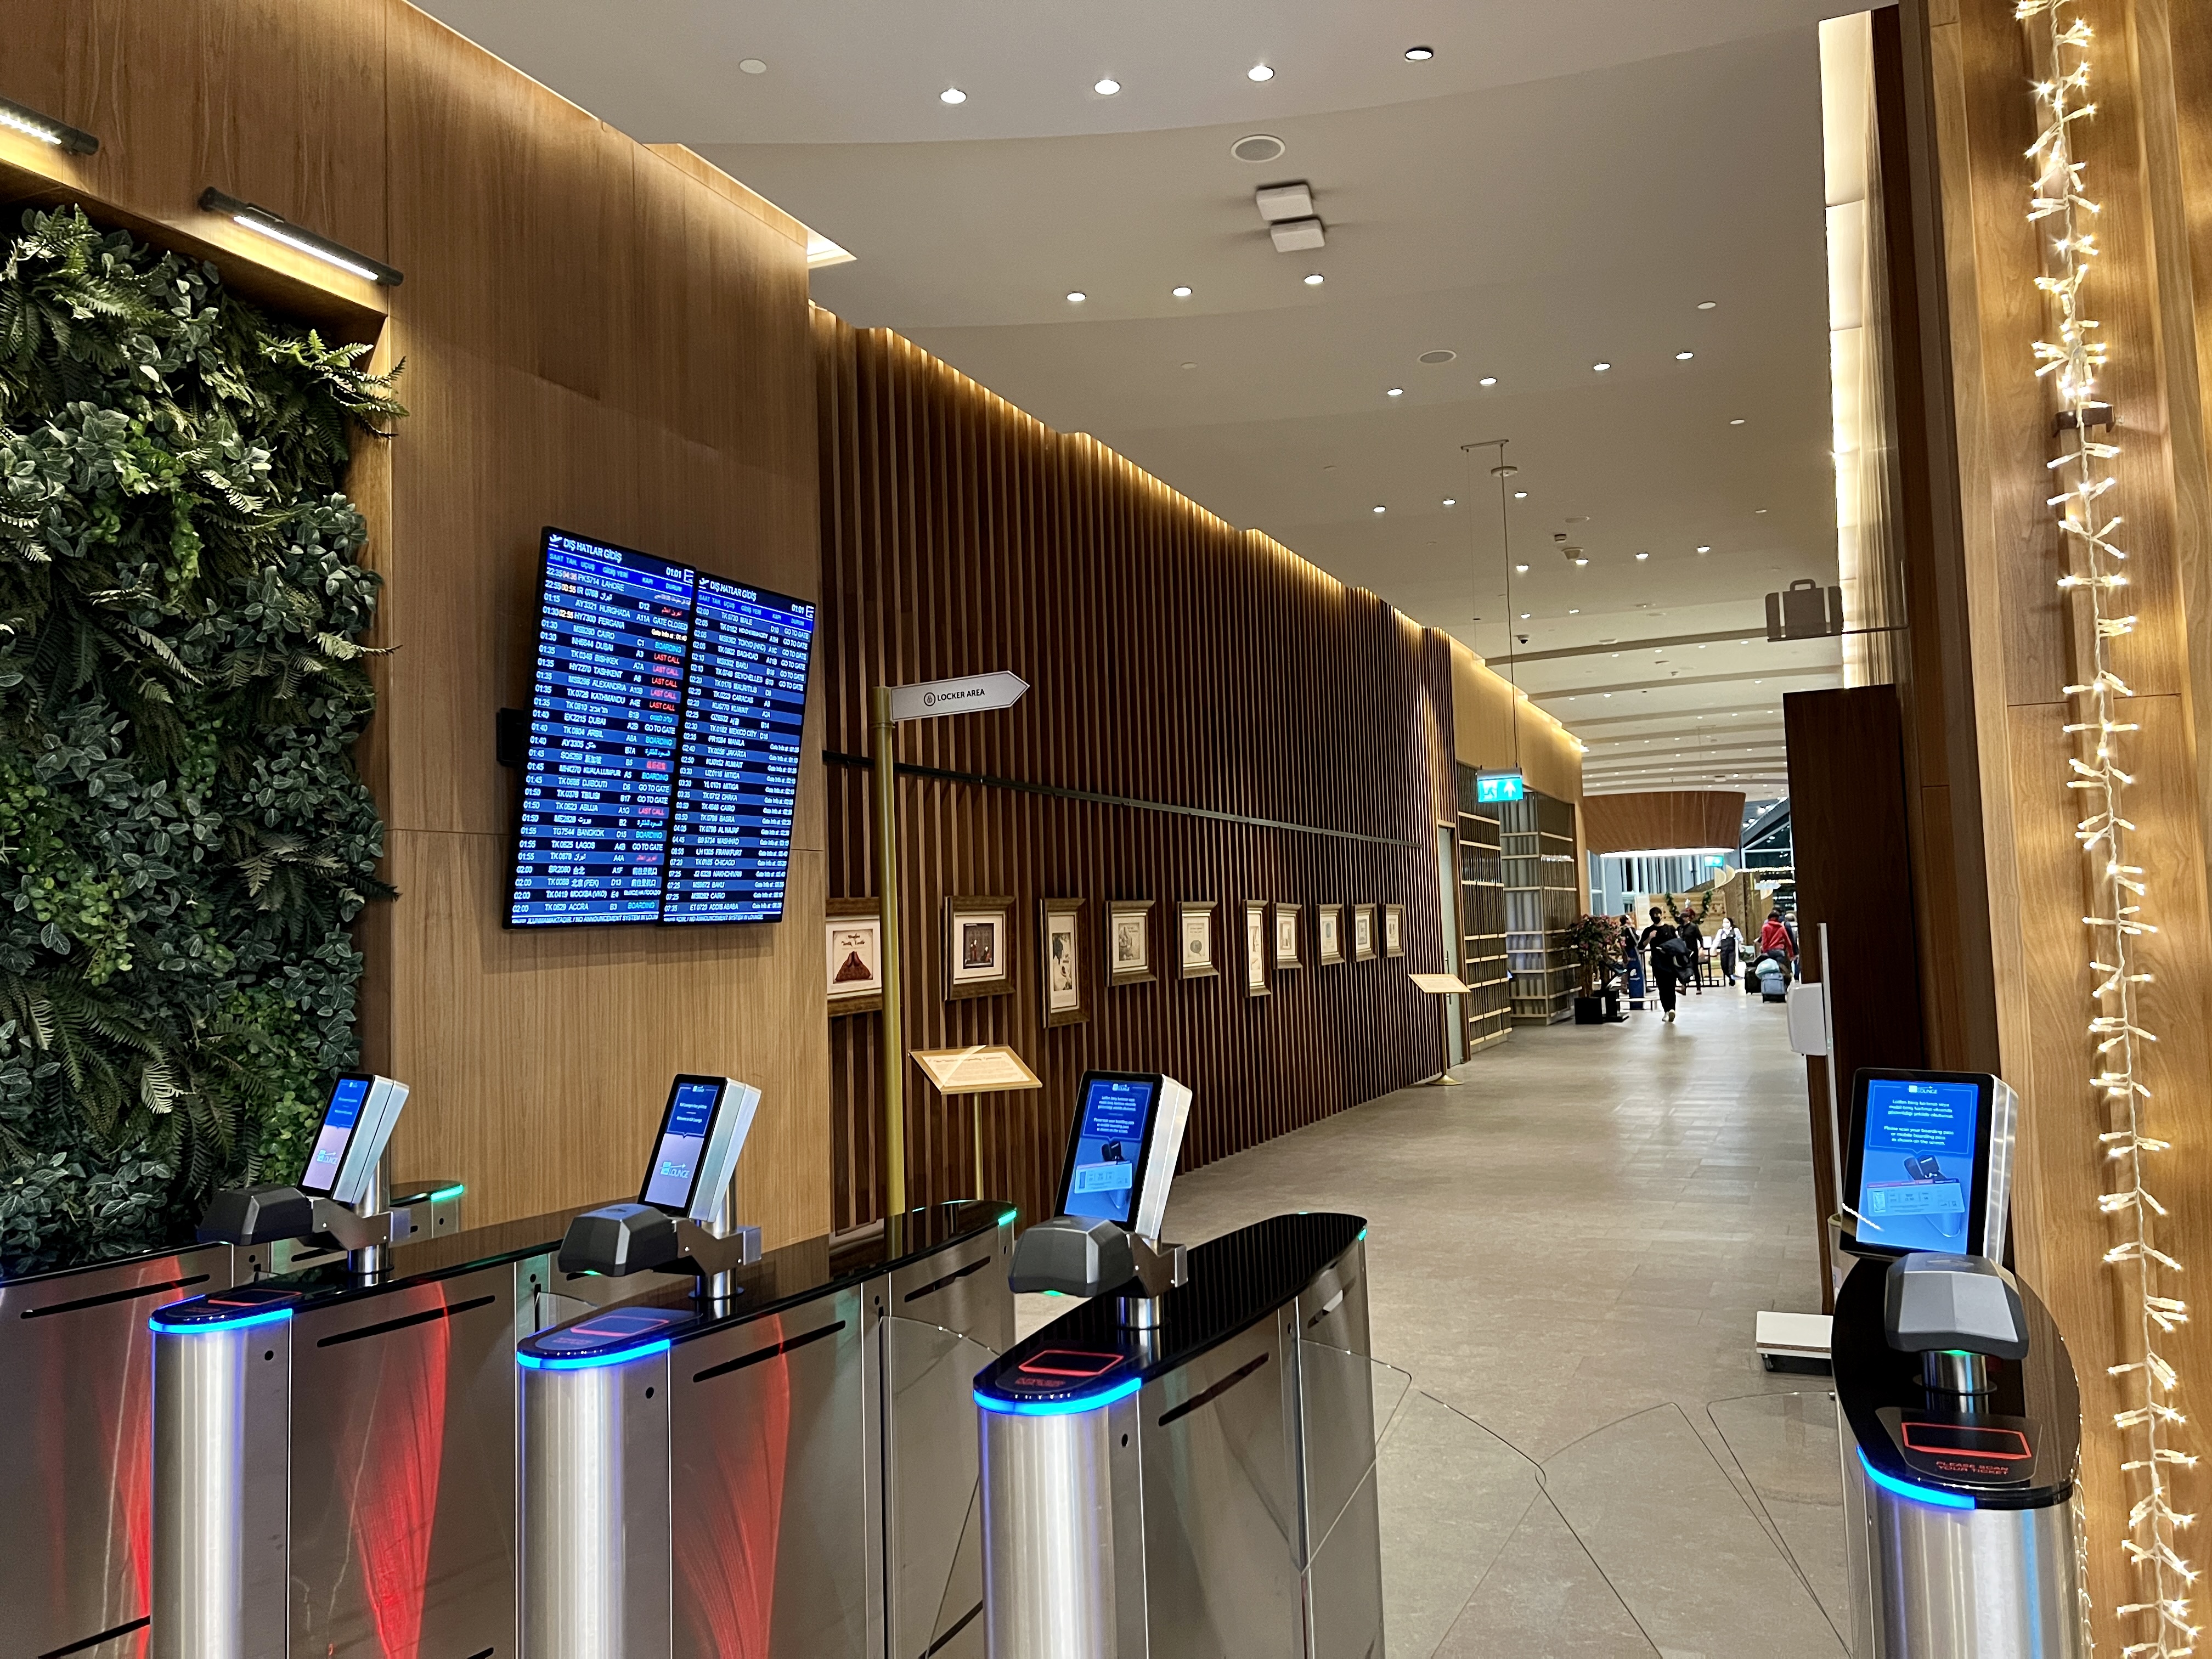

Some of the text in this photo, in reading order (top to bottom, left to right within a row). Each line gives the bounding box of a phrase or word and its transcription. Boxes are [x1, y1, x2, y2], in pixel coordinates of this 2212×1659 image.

[549, 552, 563, 563] SAAT
[563, 538, 681, 578] DIŞ HATLAR GİDİŞ 01:01
[546, 567, 624, 591] 22:35 LAHORE
[545, 579, 650, 611] 22:55 D12
[720, 584, 741, 597] HATLAR
[742, 589, 757, 602] GİDİŞ
[542, 606, 625, 629] 01:30 FERGANA
[544, 592, 560, 603] 01:15
[599, 604, 630, 618] HURGHADA
[652, 616, 667, 626] GATE
[667, 619, 688, 630] CLOSED
[541, 619, 681, 653] 01:30 CAIRO BOARDING
[540, 631, 557, 641] 01:30
[595, 641, 613, 651] DUBAI
[654, 653, 667, 661] LAST
[667, 656, 680, 664] CALL
[539, 645, 555, 654] 01:35
[594, 654, 619, 665] BISHKEK
[653, 665, 665, 673] LAST
[665, 668, 679, 676] CALL
[735, 661, 748, 669] BAKU
[537, 657, 677, 687] 01:35 TASHKENT LAST CALL
[734, 672, 763, 683] SEYCHELLES
[535, 684, 551, 693] 01:35
[590, 692, 625, 704] KATHMANDU
[536, 670, 676, 699] 01:35 ALEXANDRIA LAST CALL
[533, 697, 550, 707] 01:35
[732, 694, 754, 703] CARACAS
[937, 689, 985, 701] LOCKER AREA
[532, 709, 549, 719] 01:40
[588, 716, 606, 725] DUBAI
[661, 726, 675, 734] GATE
[529, 736, 546, 744] 01:40
[531, 723, 673, 746] 01:40 BOARDING
[726, 749, 747, 758] JAKARTA
[527, 761, 668, 781] 01:45 BOARDING
[582, 779, 607, 788] DJIBOUTI
[523, 800, 540, 809] 01:50
[579, 803, 598, 811] ABUJA
[580, 791, 600, 799] TBILISI
[654, 796, 668, 804] GATE
[577, 828, 605, 837] BANGKOK
[635, 831, 663, 839] BOARDING
[519, 839, 535, 848] 01:55
